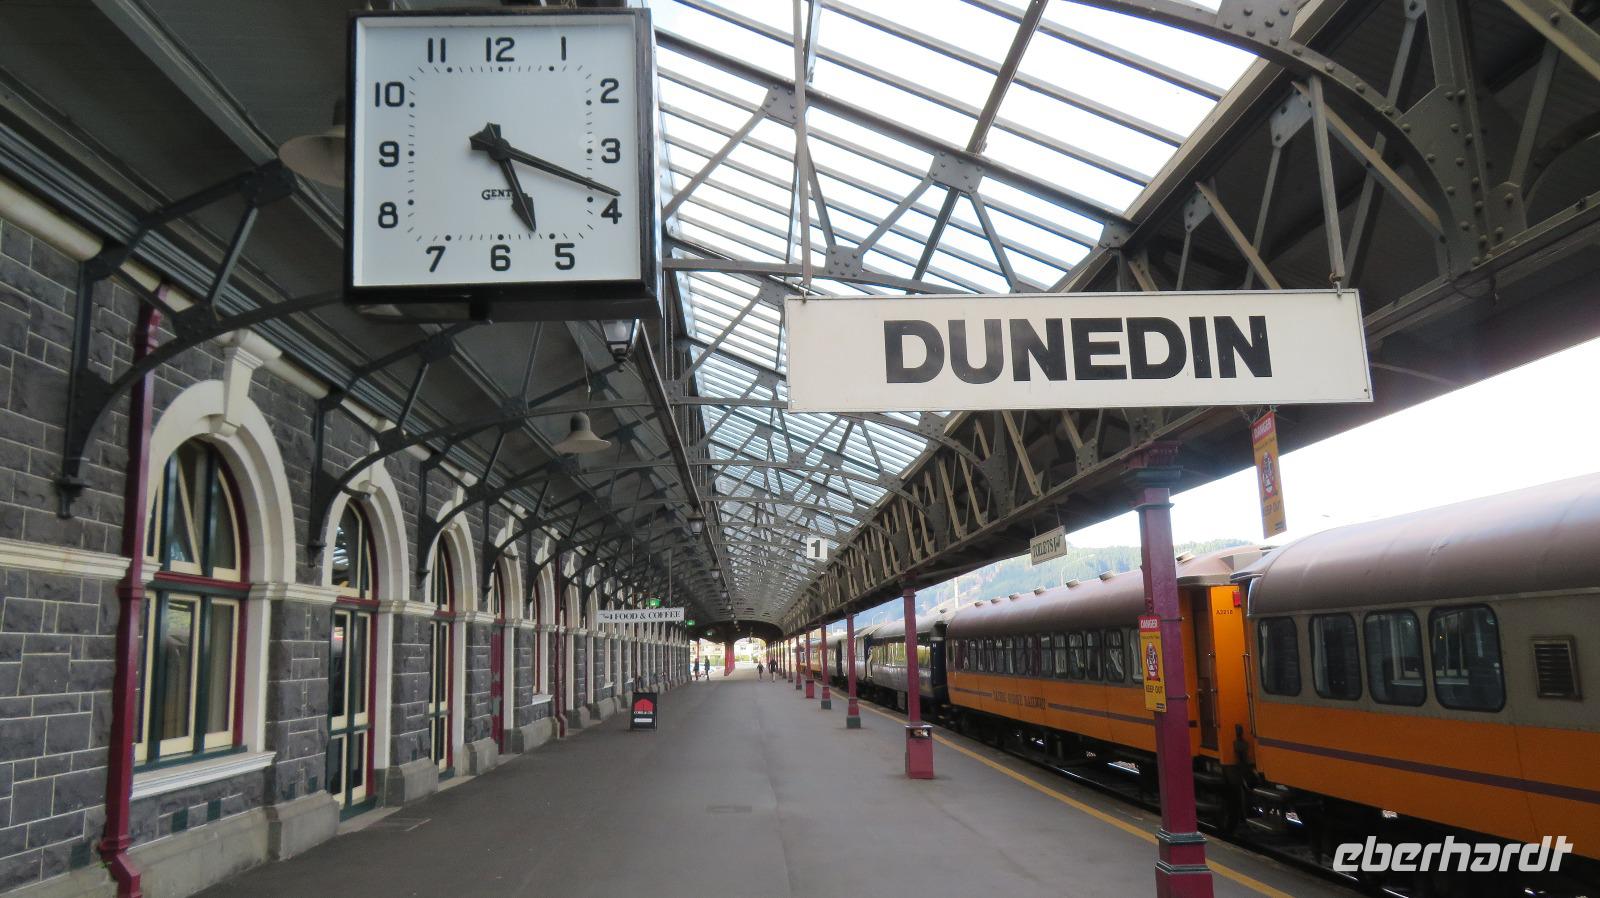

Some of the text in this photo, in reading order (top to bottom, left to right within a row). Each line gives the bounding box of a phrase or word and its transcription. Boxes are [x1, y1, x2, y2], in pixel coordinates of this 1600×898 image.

[427, 37, 447, 63] 11
[485, 37, 515, 63] 12
[560, 36, 567, 61] 1
[374, 81, 405, 108] 10
[600, 78, 620, 104] 2
[379, 141, 400, 167] 9
[600, 138, 621, 164] 3
[378, 202, 399, 229] 8
[600, 198, 622, 225] 4
[425, 245, 446, 273] 7
[490, 244, 511, 272] 6
[554, 242, 575, 271] 5
[883, 315, 1273, 385] DUNEDIN
[810, 539, 821, 558] 1
[615, 612, 638, 620] FOOD
[648, 610, 681, 619] COFFEE
